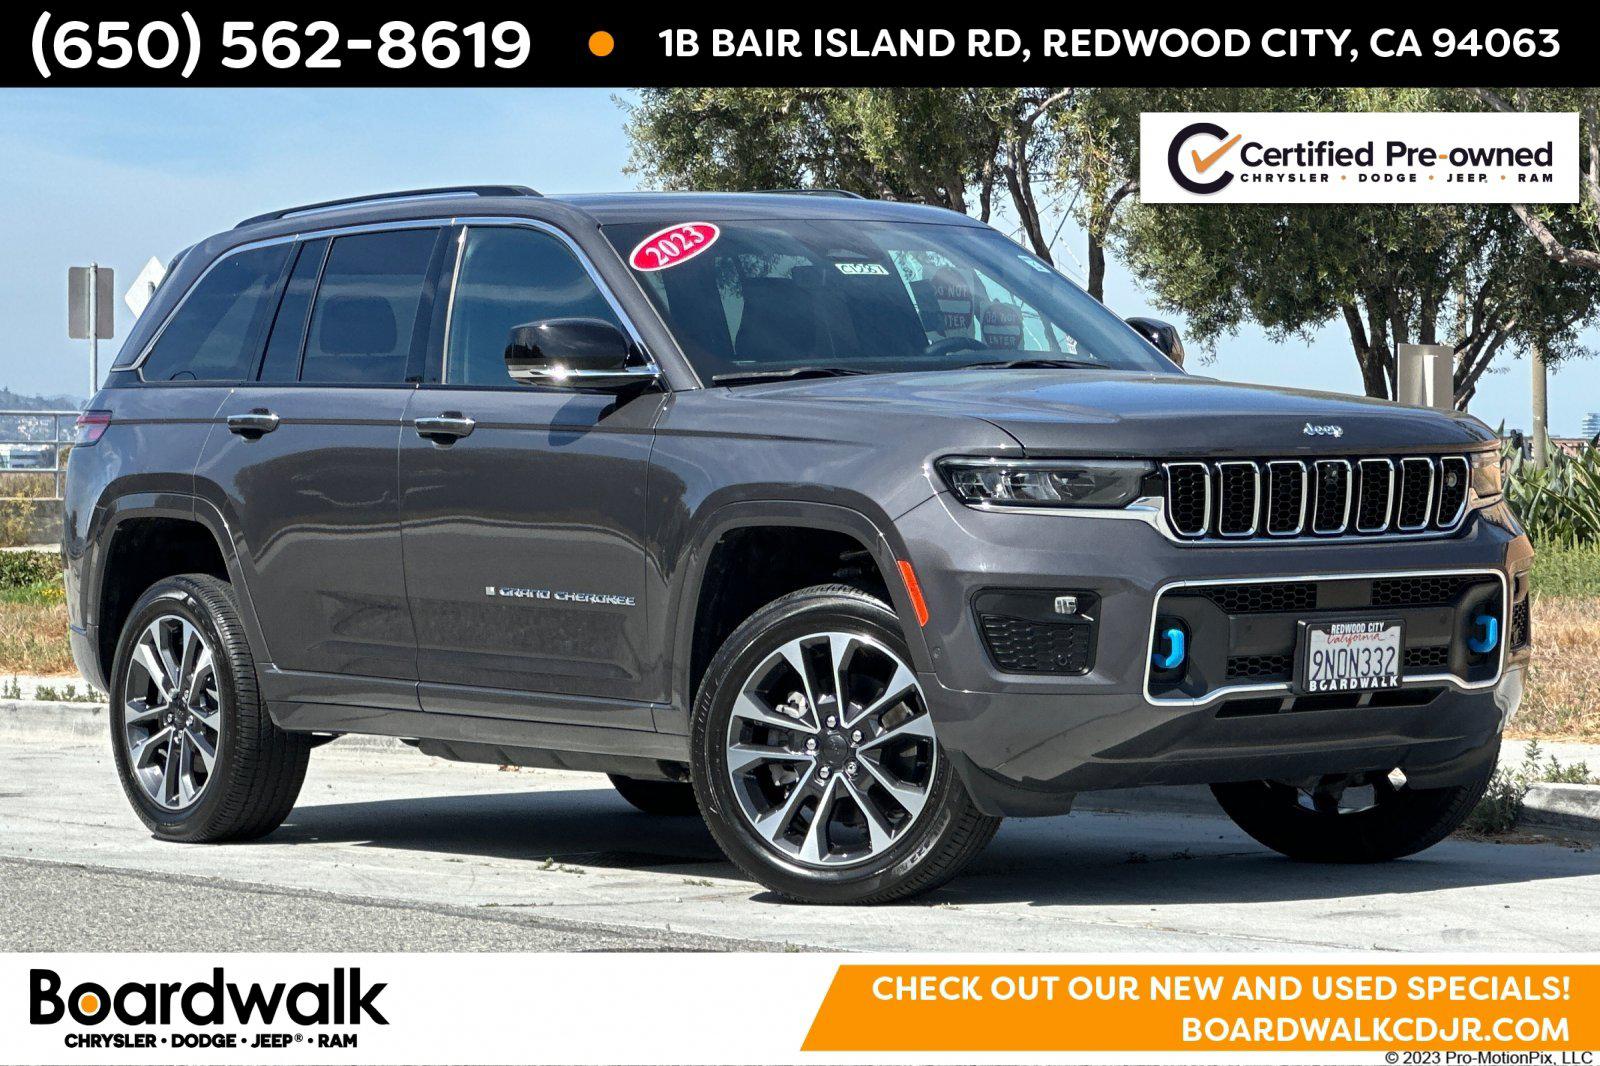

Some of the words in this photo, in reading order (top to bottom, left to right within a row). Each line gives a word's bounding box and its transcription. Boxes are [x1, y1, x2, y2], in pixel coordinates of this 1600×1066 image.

[645, 225, 705, 266] 2023
[1303, 422, 1344, 438] Jeep
[499, 587, 551, 599] GRAND
[554, 591, 636, 606] CHEROKEE
[1331, 623, 1366, 634] REDWOOD
[1367, 622, 1385, 632] CITY
[1326, 632, 1386, 647] California
[1309, 675, 1399, 692] BOARDWALK
